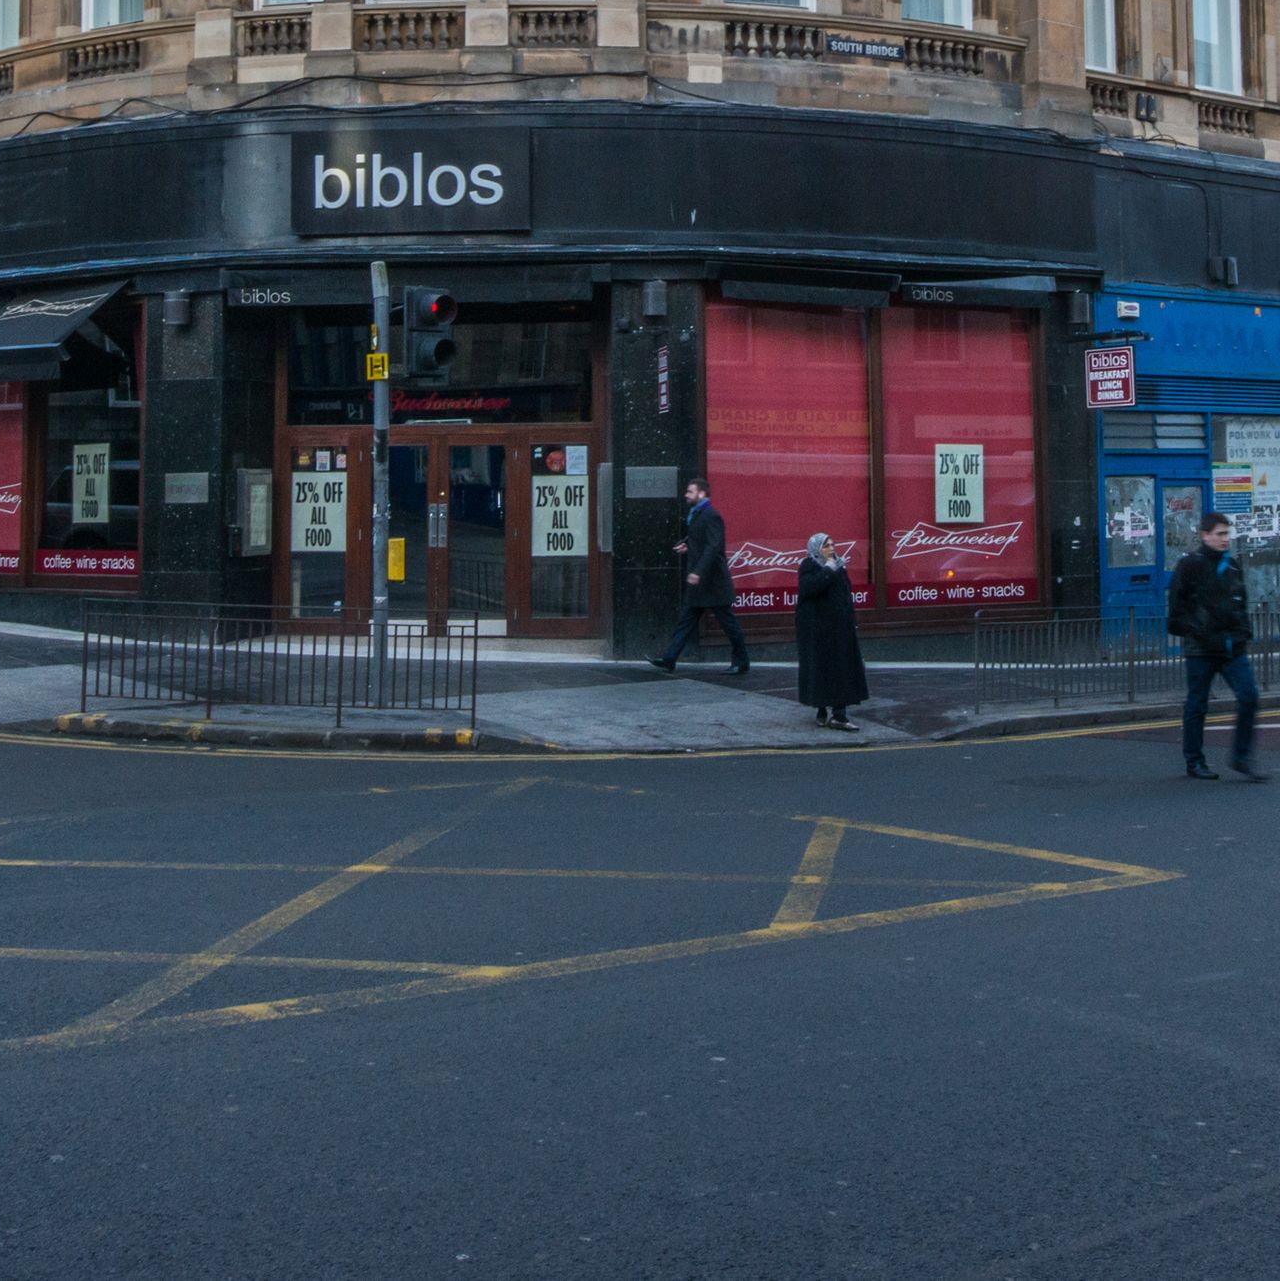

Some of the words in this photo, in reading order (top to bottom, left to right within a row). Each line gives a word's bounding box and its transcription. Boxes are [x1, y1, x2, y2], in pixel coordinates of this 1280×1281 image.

[831, 40, 862, 54] SOUTH
[865, 44, 900, 57] BRIDGE
[314, 151, 504, 209] biblos
[240, 289, 291, 304] biblos
[912, 287, 954, 302] biblos
[1090, 353, 1128, 367] biblos
[1089, 369, 1130, 380] BREAKFAST
[1097, 390, 1124, 400] DINNER
[1098, 381, 1122, 391] LUNCH
[1229, 430, 1272, 439] POLWORK
[76, 453, 91, 476] 25%
[93, 453, 106, 474] OFF
[939, 453, 960, 475] 25%
[963, 454, 980, 475] OFF
[85, 478, 96, 497] ALL
[295, 481, 320, 504] 25%
[324, 481, 343, 503] OFF
[535, 485, 560, 508] 25%
[564, 485, 584, 507] OFF
[952, 478, 967, 497] ALL
[81, 500, 99, 518] FOOD
[310, 506, 327, 525] ALL
[948, 499, 971, 518] FOOD
[551, 510, 568, 529] ALL
[305, 528, 332, 547] FOOD
[546, 532, 574, 551] FOOD
[891, 529, 1019, 548] Budweiser
[44, 555, 71, 569] coffee
[75, 555, 97, 568] wine
[101, 555, 135, 570] snacks
[732, 591, 774, 608] akfast
[898, 586, 938, 601] coffee
[946, 584, 975, 599] wine
[982, 583, 1025, 598] snacks
